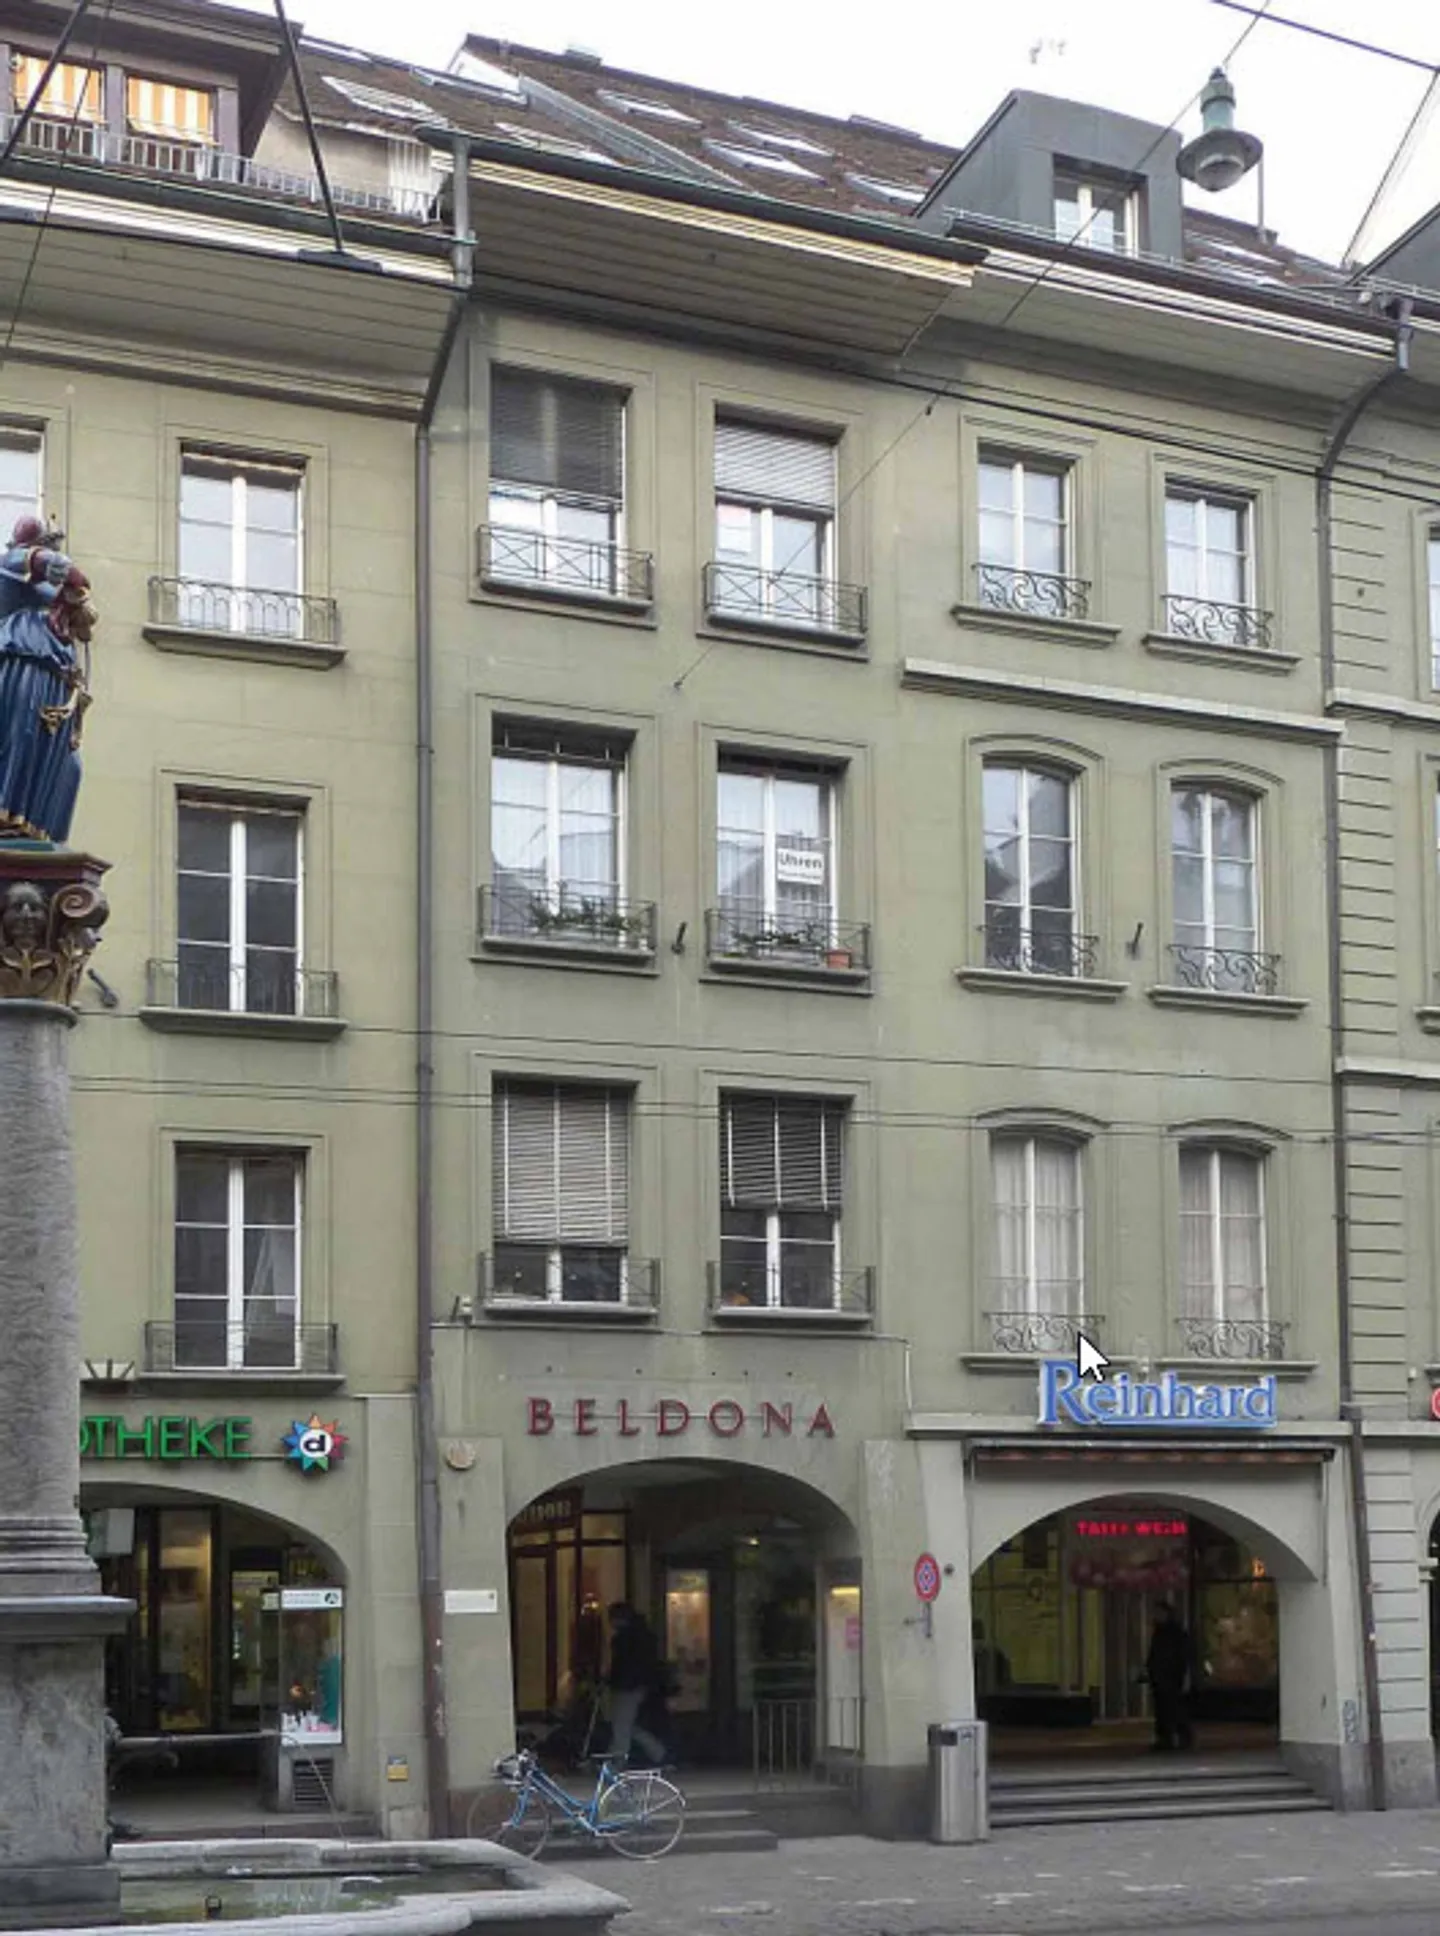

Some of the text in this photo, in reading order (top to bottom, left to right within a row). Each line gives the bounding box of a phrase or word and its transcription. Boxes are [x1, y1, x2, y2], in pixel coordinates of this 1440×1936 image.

[780, 852, 822, 868] Uhren
[1033, 1359, 1277, 1427] Reinhard
[80, 1415, 252, 1459] THEKE
[527, 1397, 835, 1437] BELDONA
